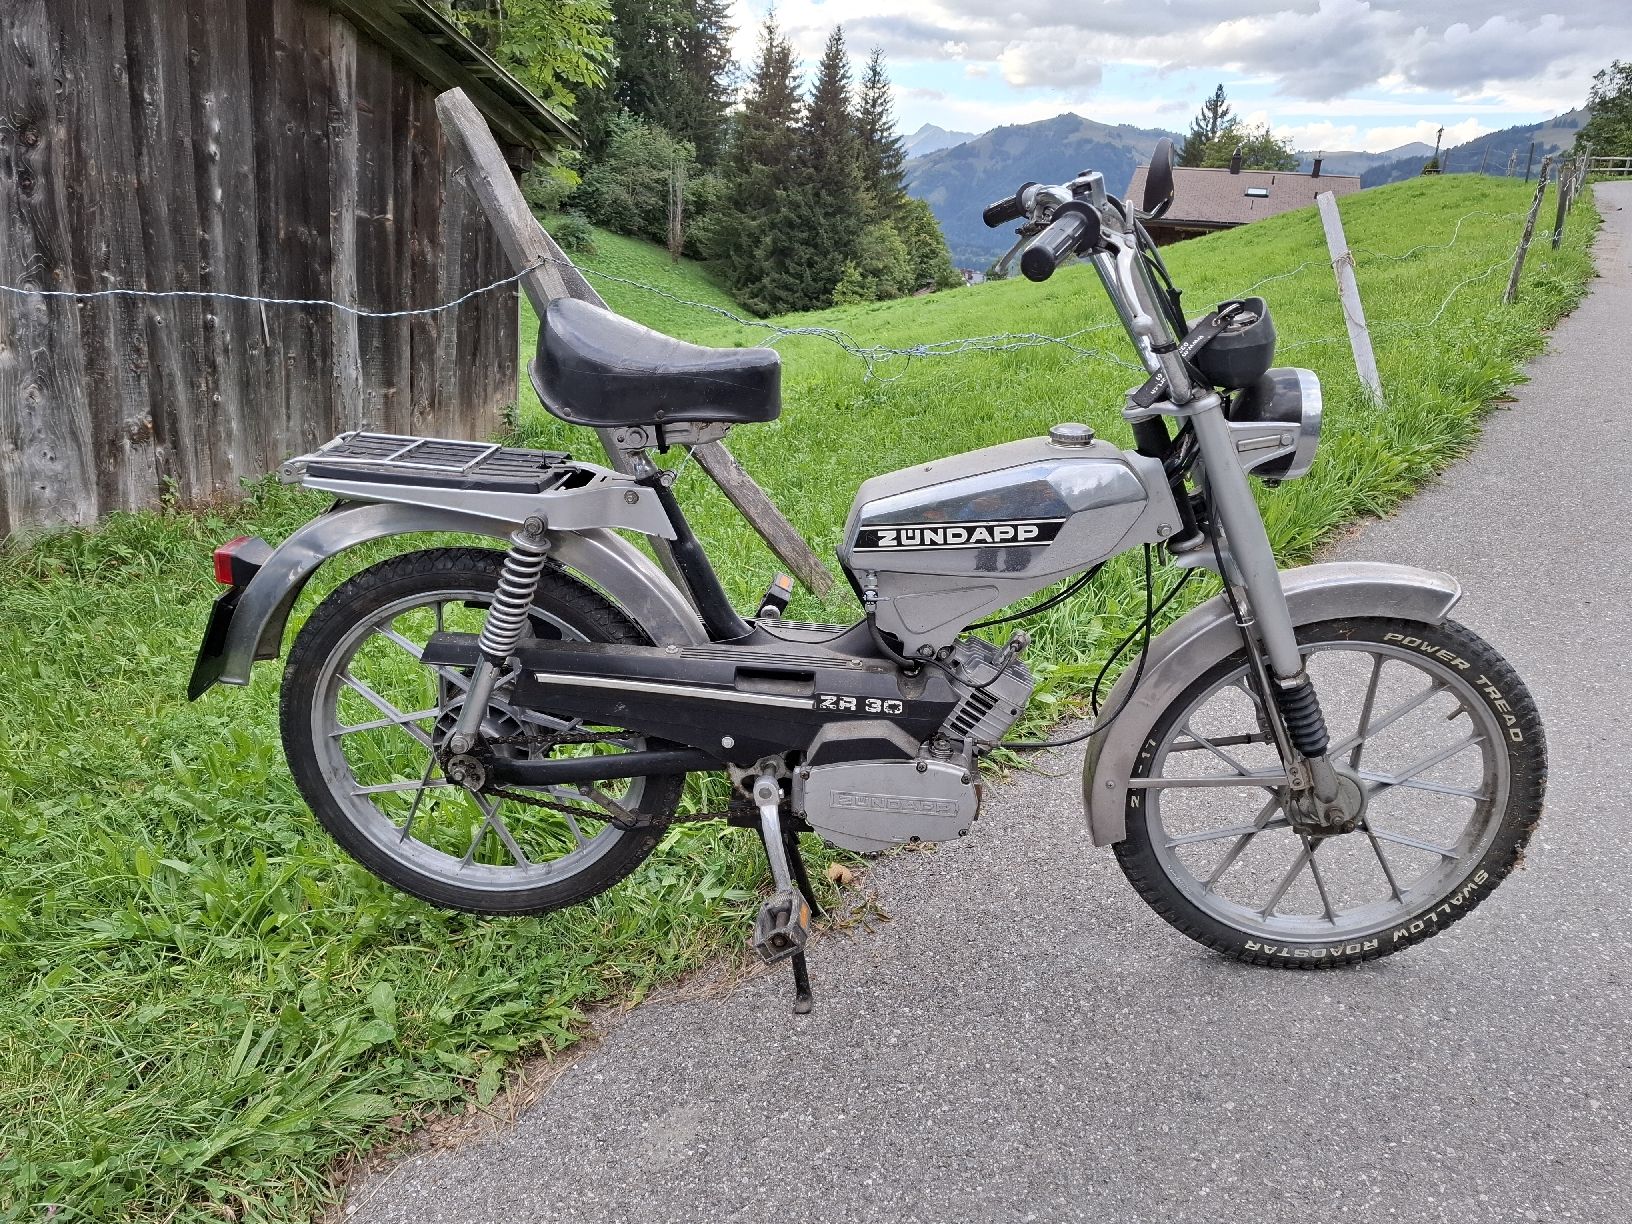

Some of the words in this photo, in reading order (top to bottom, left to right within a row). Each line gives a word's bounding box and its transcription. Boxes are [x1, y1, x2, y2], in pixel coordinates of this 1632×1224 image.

[877, 525, 1039, 547] ZÜNDAPP
[1383, 632, 1471, 670] POWER
[1475, 674, 1524, 742] TREAD
[819, 695, 857, 711] ZR
[865, 698, 903, 714] 30
[1393, 869, 1489, 942] SWALLOW
[1244, 938, 1379, 958] ROADSTAR
